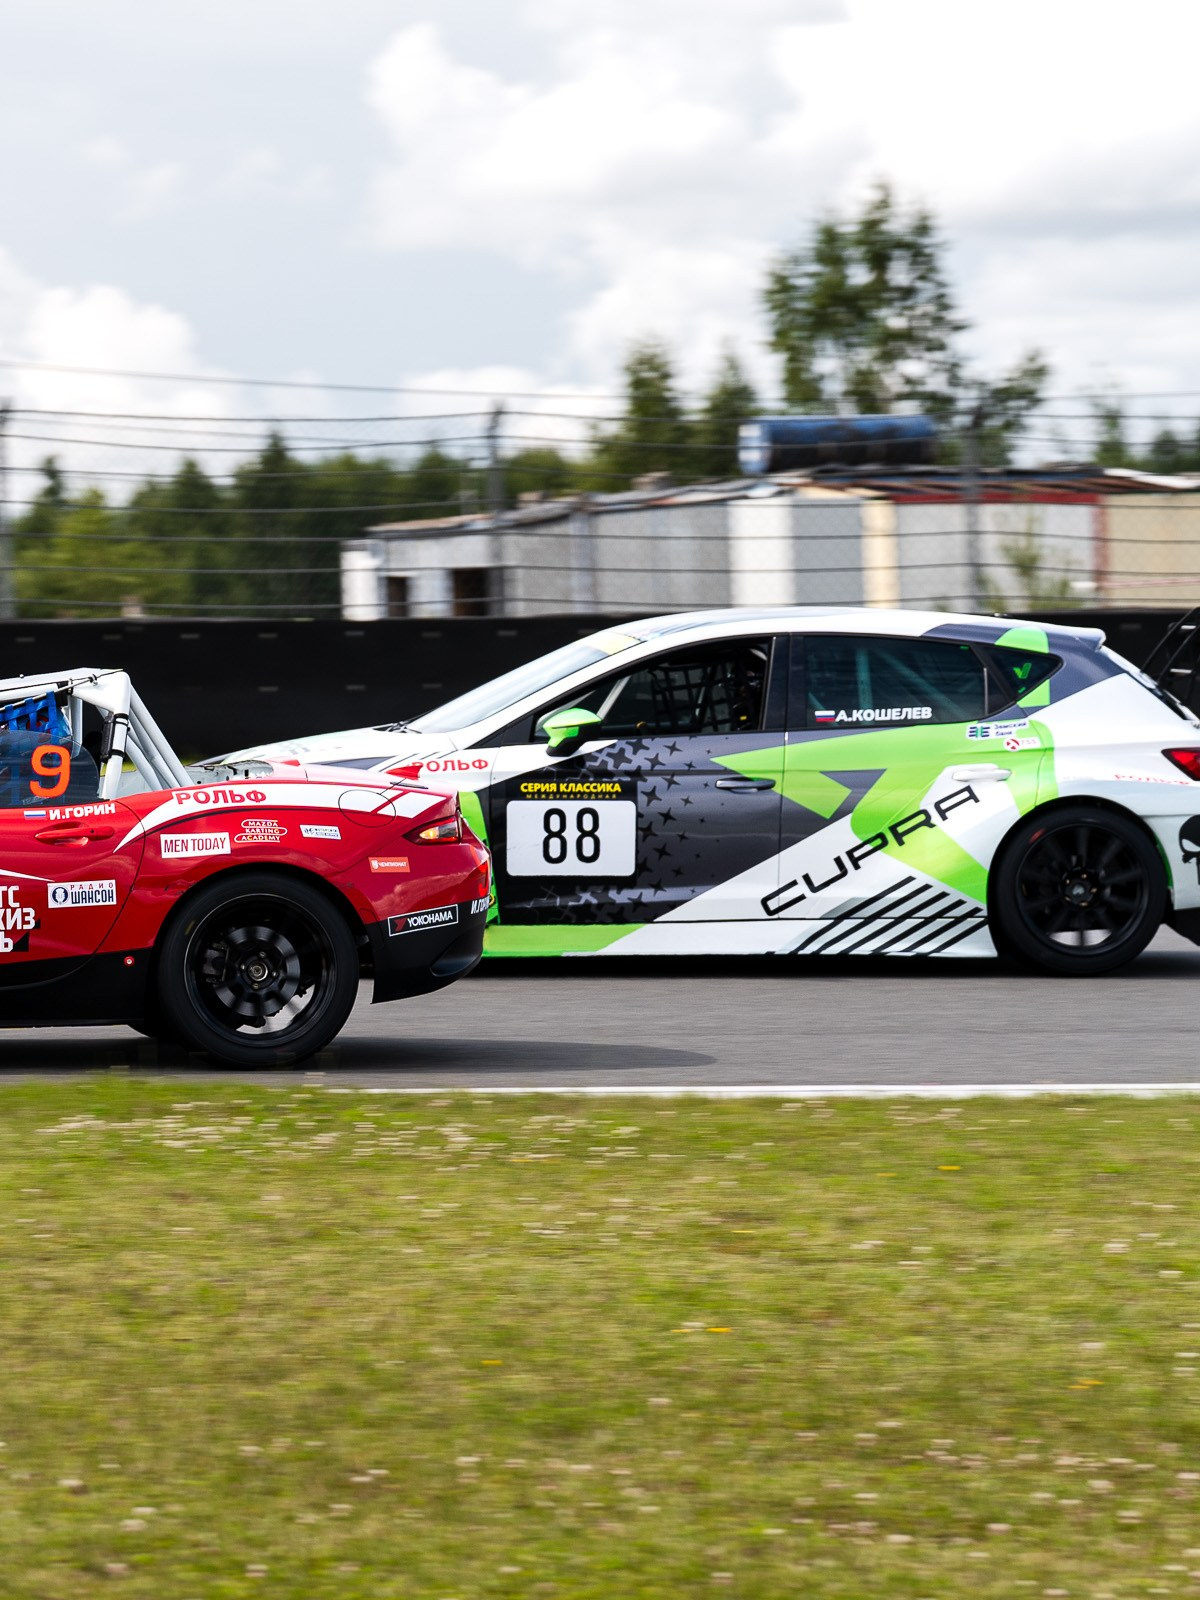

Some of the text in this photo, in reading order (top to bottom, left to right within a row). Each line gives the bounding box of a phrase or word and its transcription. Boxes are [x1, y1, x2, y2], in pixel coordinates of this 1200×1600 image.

[835, 707, 933, 722] А.КОШЕЛЕВ
[29, 744, 71, 799] 9
[520, 782, 622, 793] СЕРИЯ КЛАССИКА
[175, 789, 267, 805] РОЛЬФ
[49, 803, 116, 820] И.ГОРИН
[248, 820, 278, 828] MAZDA
[542, 807, 601, 864] 88
[164, 837, 226, 853] MEN TODAY
[760, 785, 980, 917] CUPRA
[70, 882, 114, 890] РАДИО
[71, 889, 114, 904] ШАНСОН
[407, 910, 453, 928] YOKOHAMA
